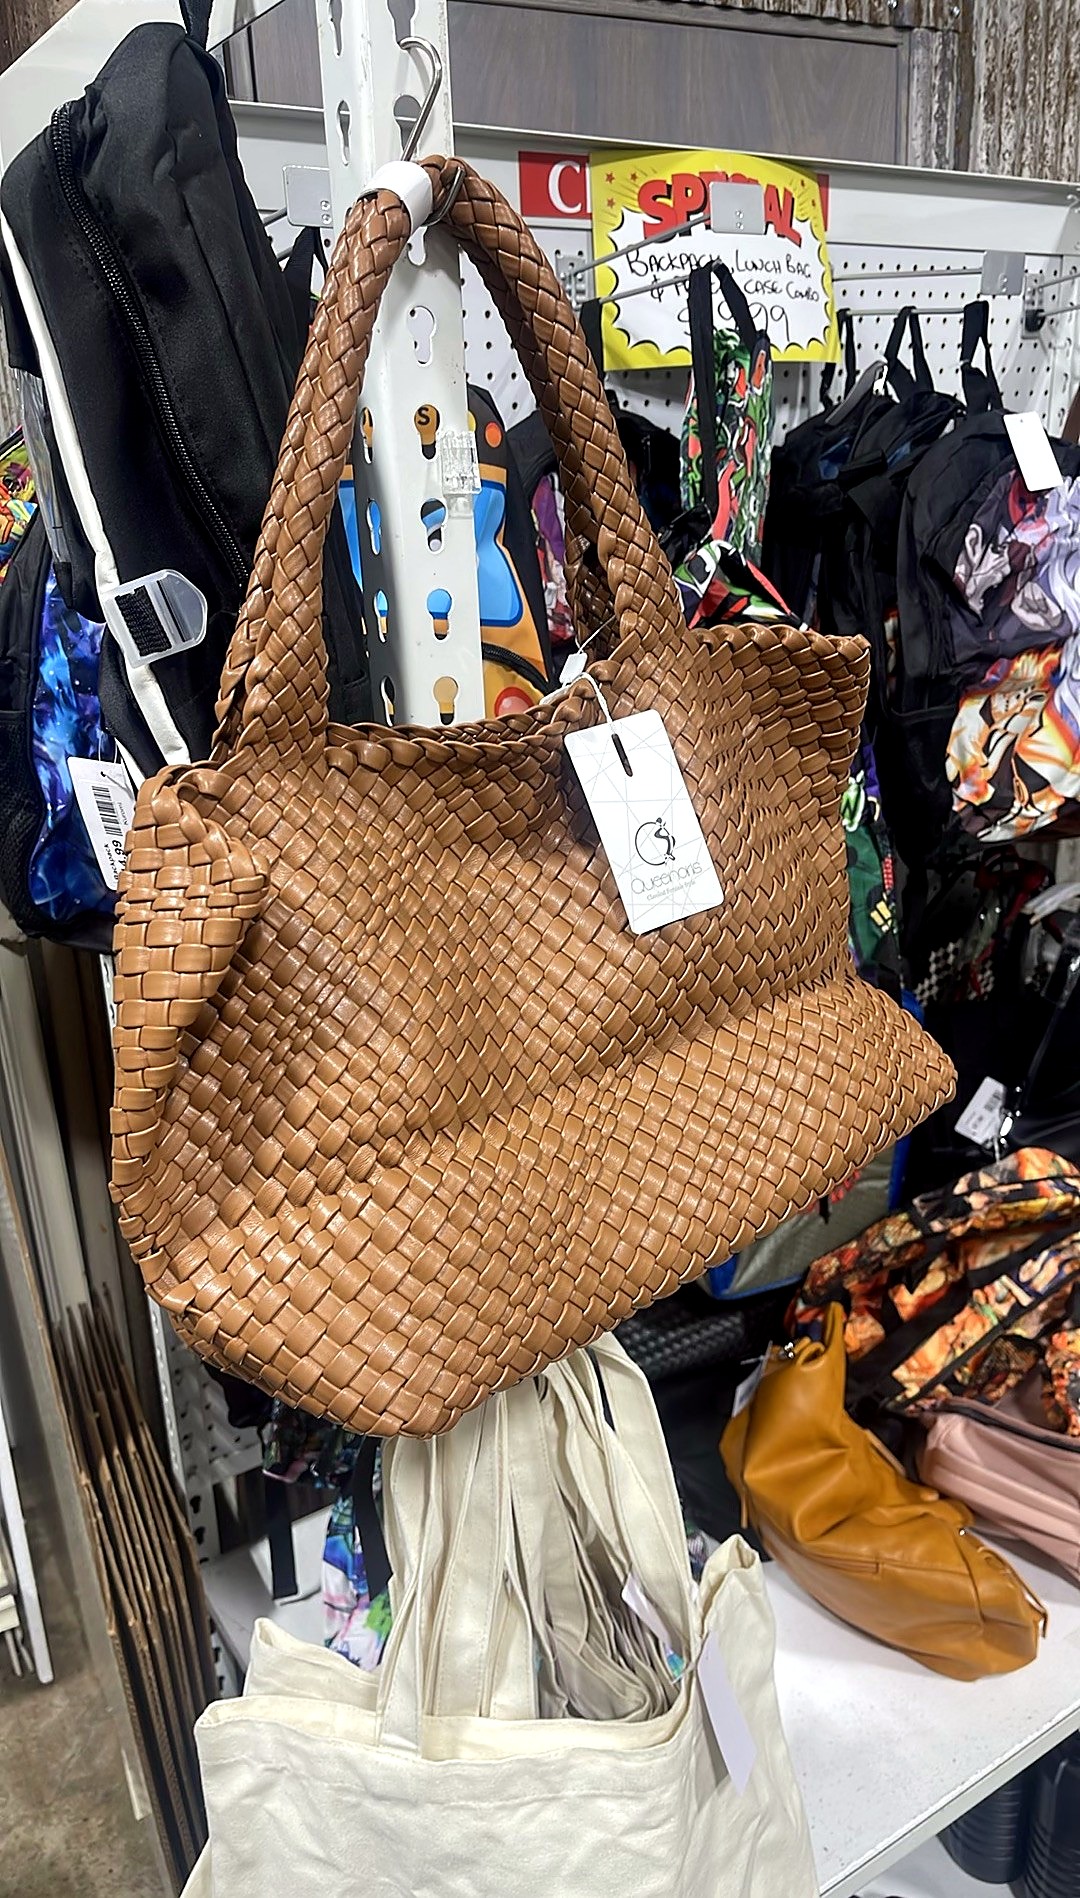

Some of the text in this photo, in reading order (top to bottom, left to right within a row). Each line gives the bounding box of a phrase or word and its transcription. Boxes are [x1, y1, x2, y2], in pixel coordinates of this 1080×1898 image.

[547, 159, 591, 214] C
[637, 171, 802, 248] SPEAL
[735, 249, 782, 274] LUNCH
[743, 278, 783, 295] CASE
